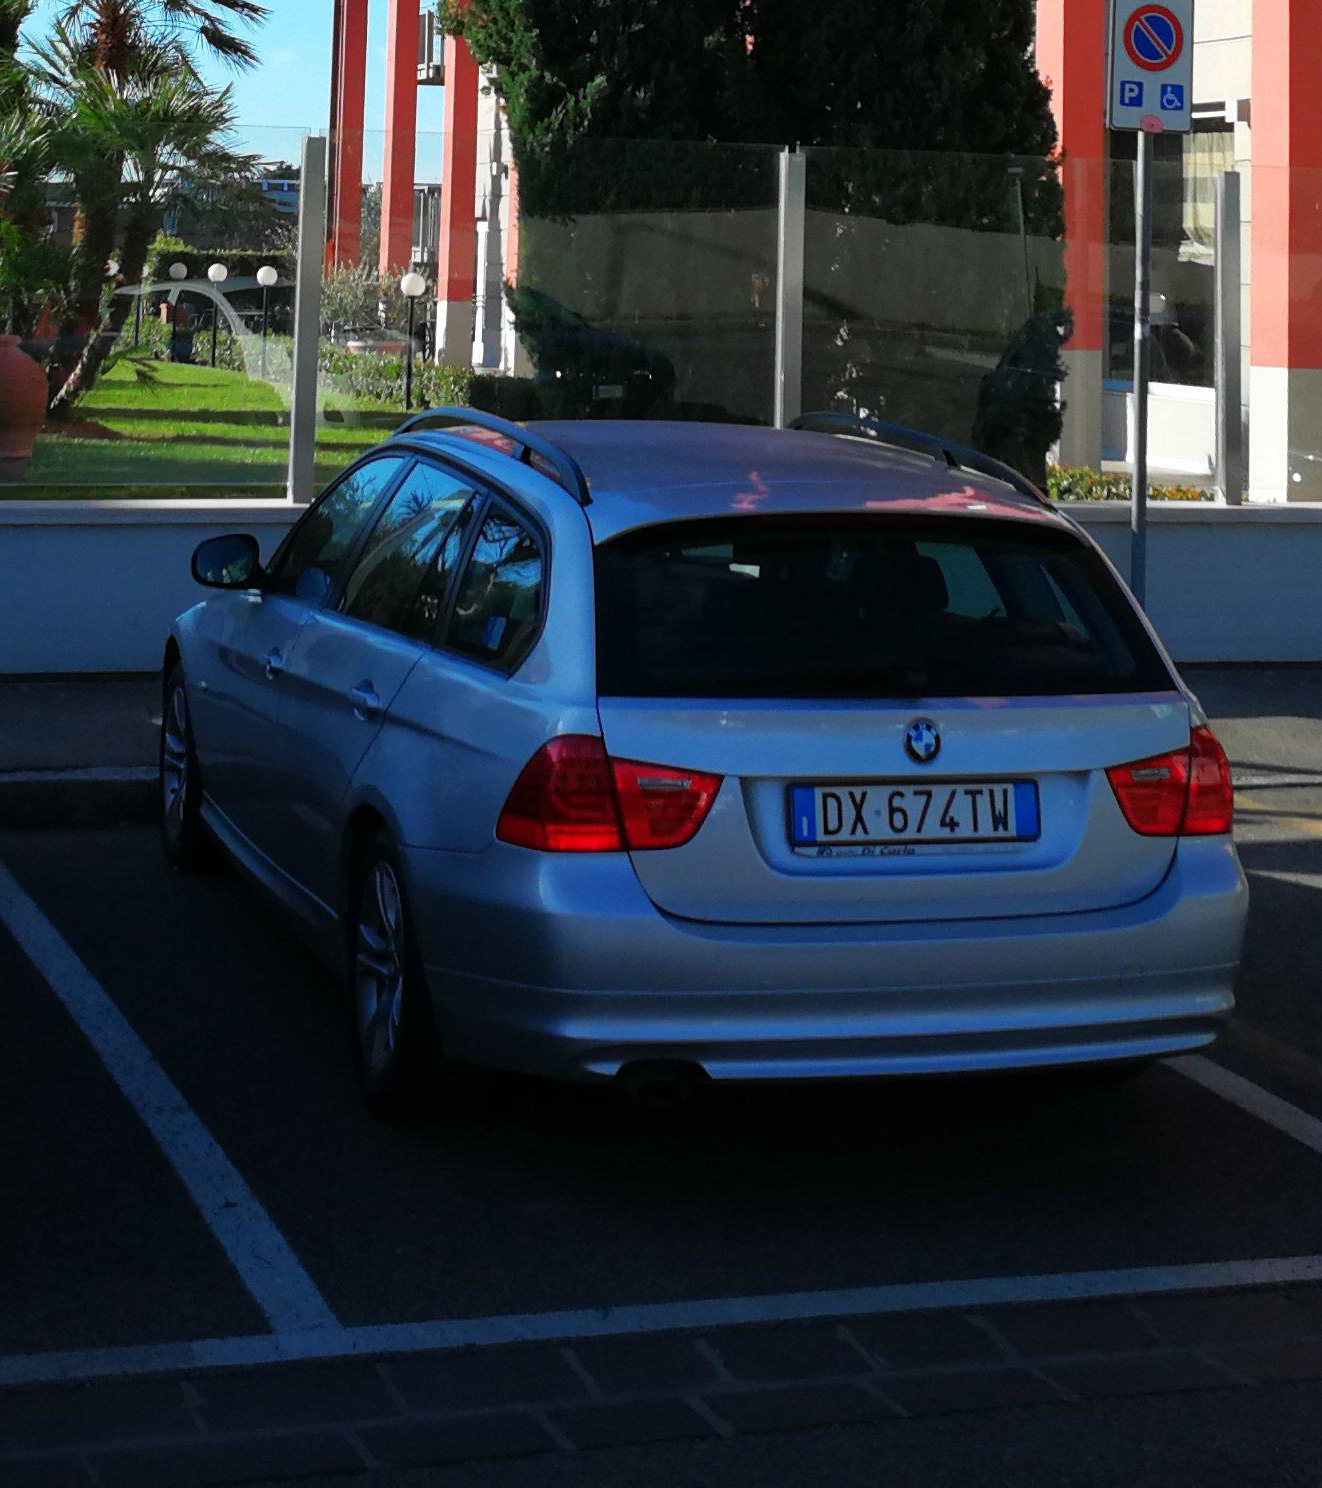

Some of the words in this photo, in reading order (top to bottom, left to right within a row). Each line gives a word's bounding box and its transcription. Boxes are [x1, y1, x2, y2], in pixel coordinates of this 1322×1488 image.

[1124, 83, 1139, 104] P
[821, 789, 870, 836] DX
[886, 787, 1010, 834] 674TW
